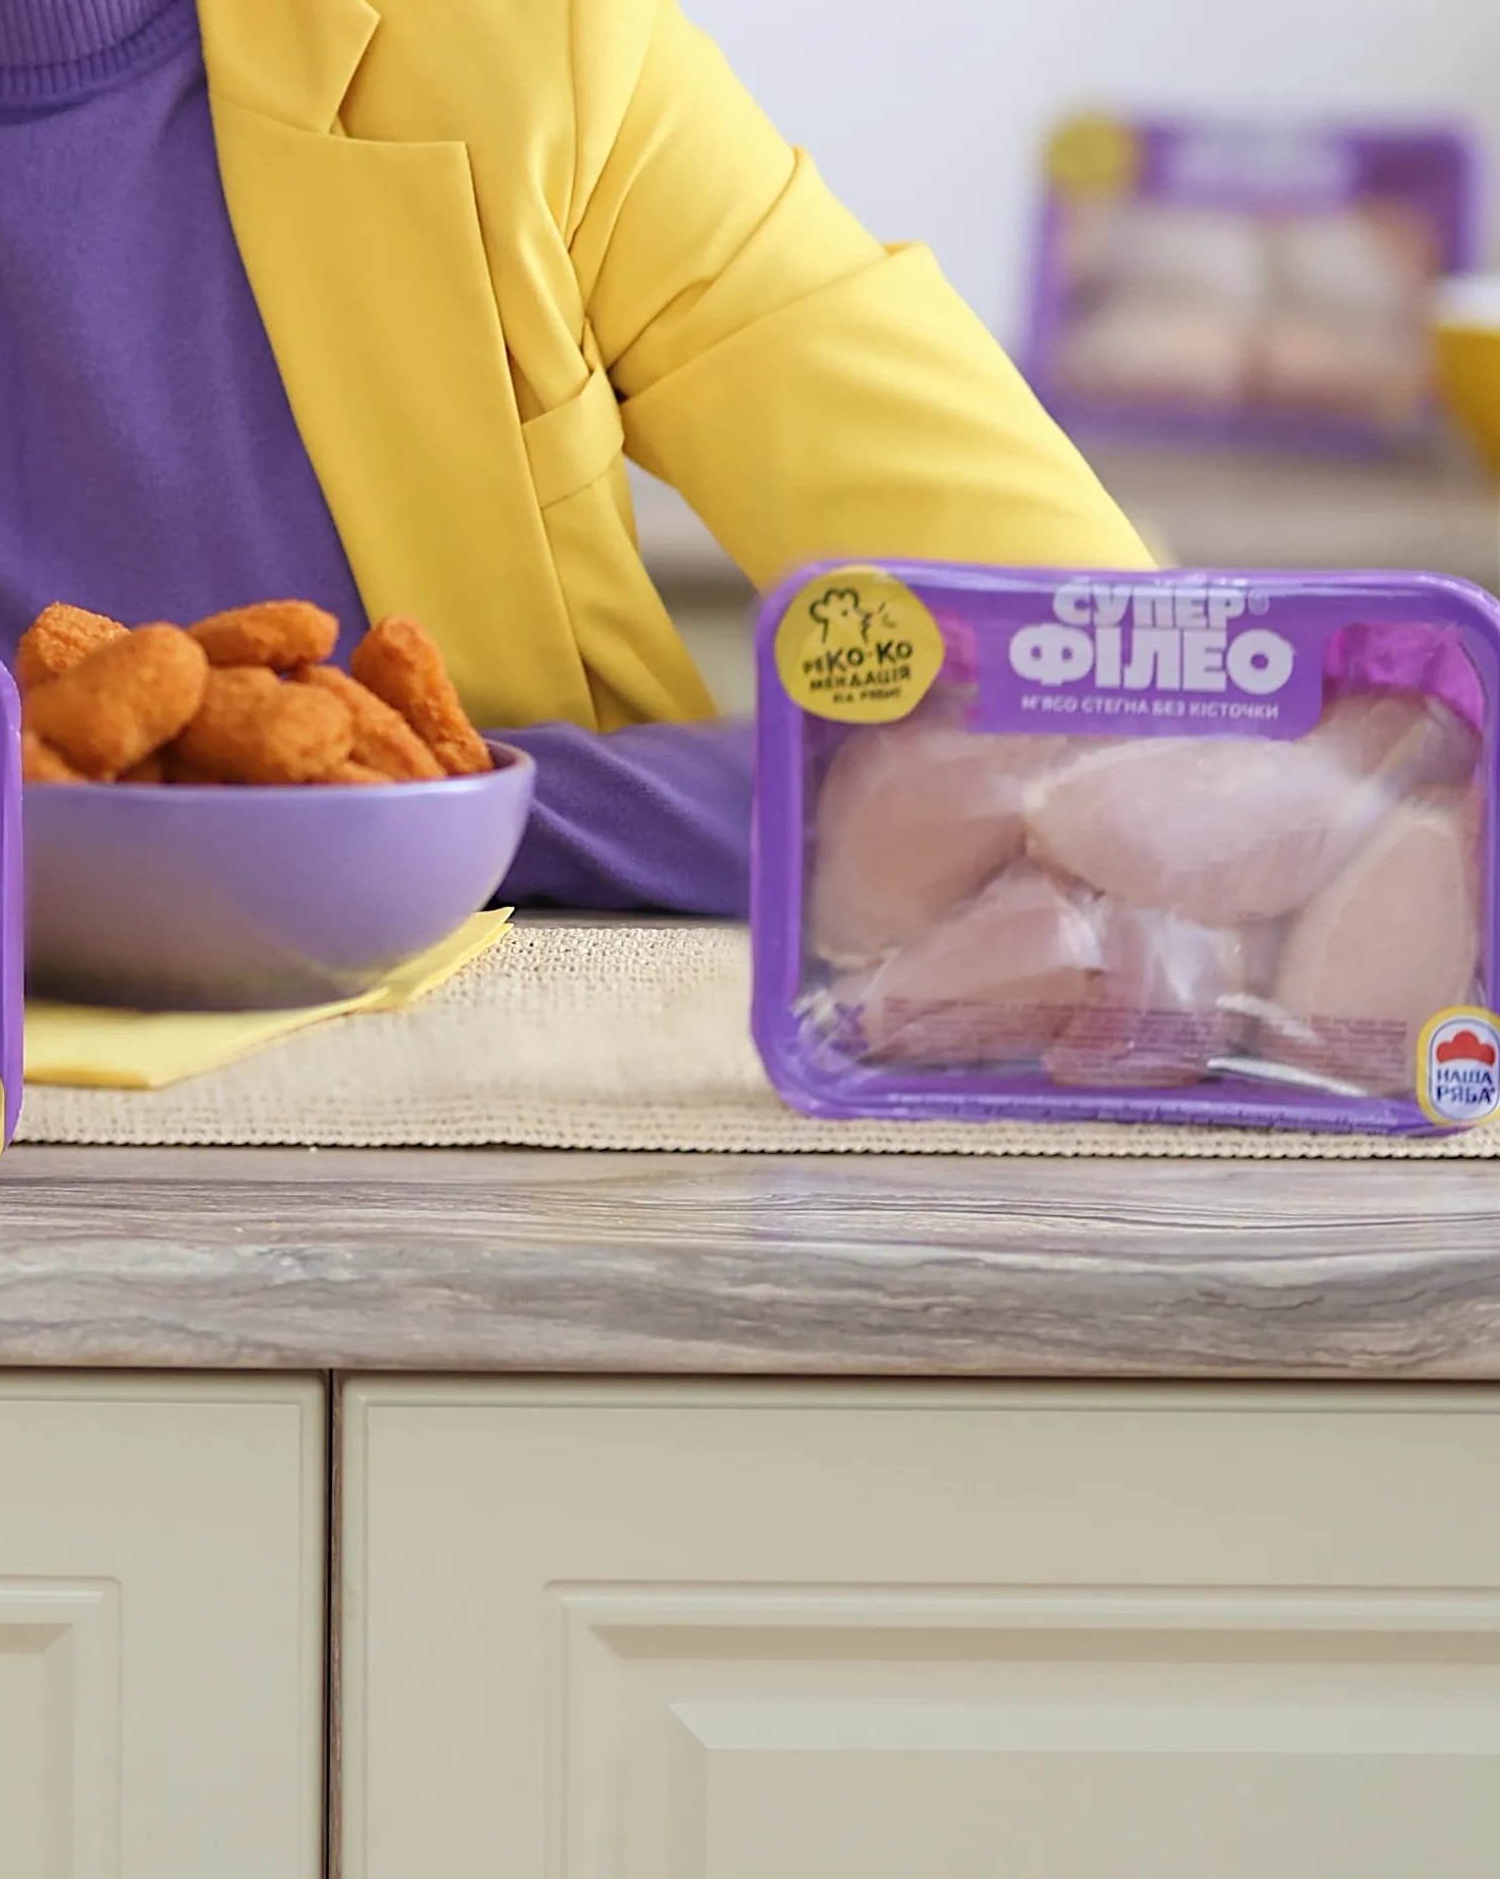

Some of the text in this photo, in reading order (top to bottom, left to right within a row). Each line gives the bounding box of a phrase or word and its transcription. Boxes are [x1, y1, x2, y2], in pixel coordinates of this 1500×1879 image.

[1052, 583, 1246, 630] СУПЕР
[1009, 623, 1294, 695] ФІЛЕО
[1081, 698, 1148, 716] СТЕГНА
[1152, 700, 1185, 716] БЕЗ
[1437, 1069, 1492, 1084] НАША
